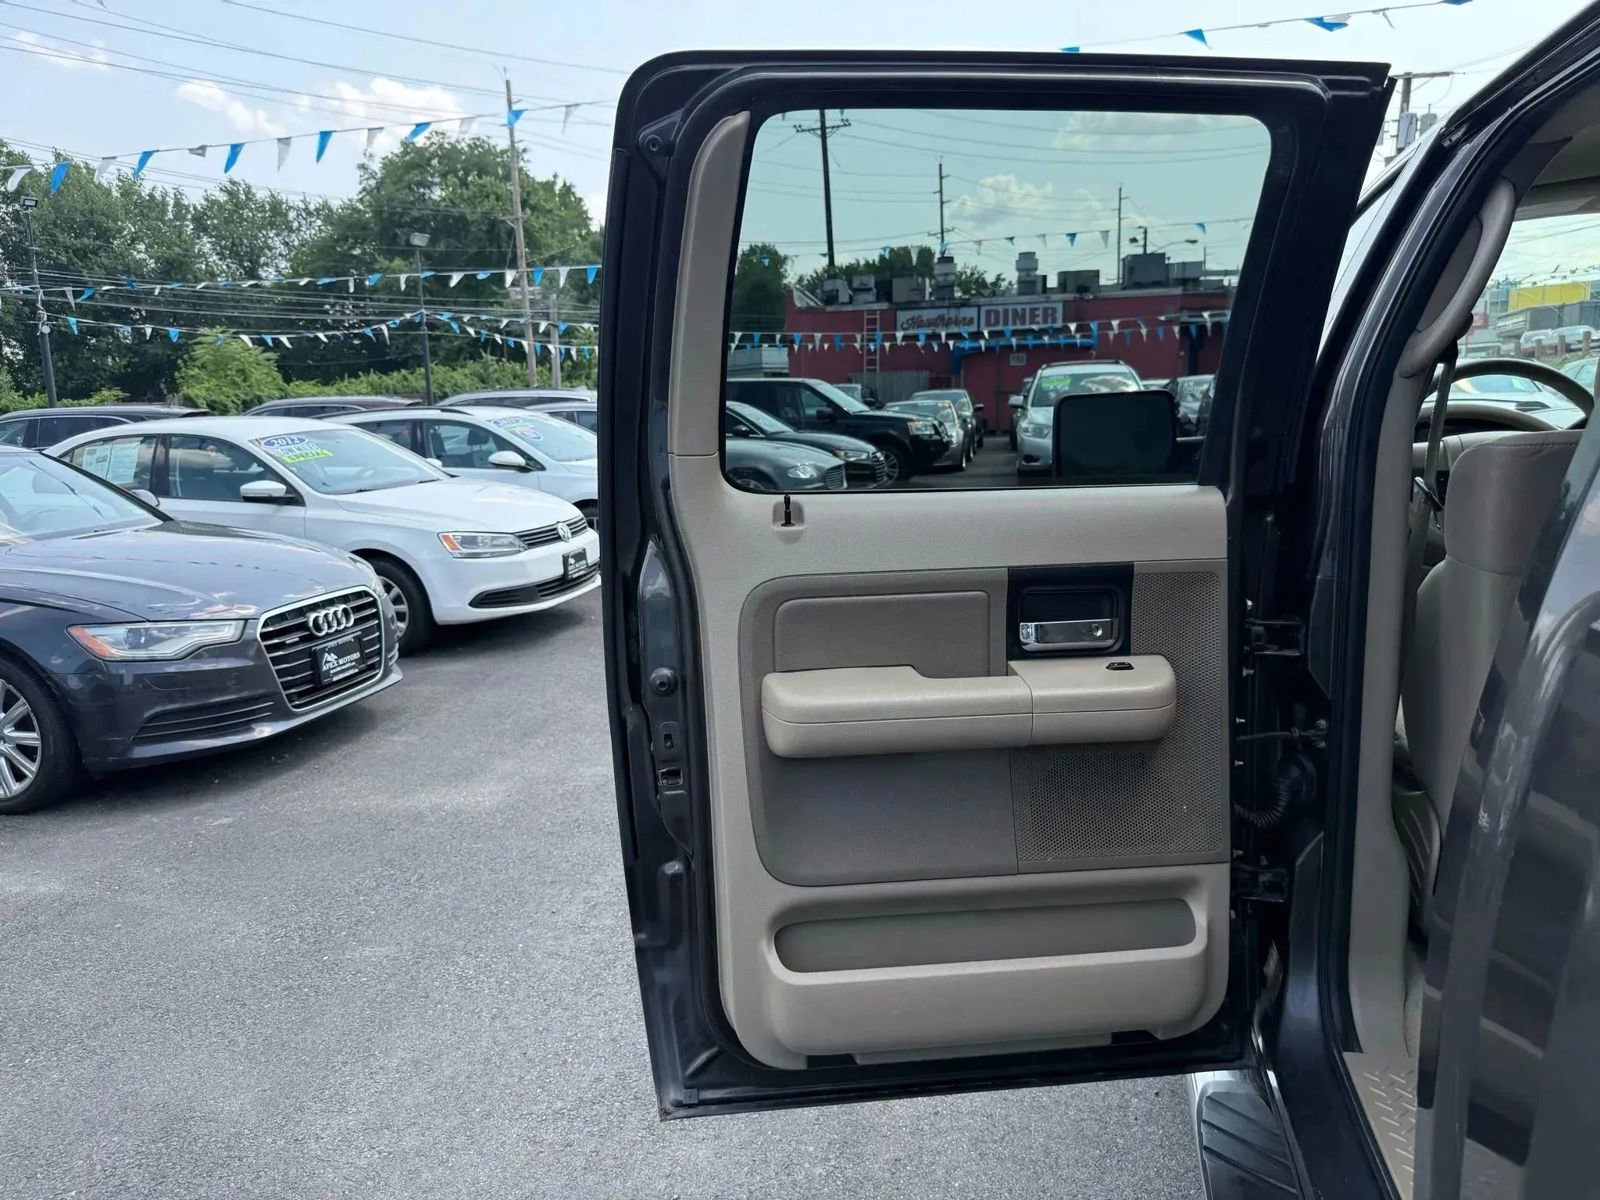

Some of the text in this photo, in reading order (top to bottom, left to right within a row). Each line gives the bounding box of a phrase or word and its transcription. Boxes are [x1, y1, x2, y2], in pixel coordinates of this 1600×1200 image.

[900, 306, 1058, 331] Hawthorne DINER
[270, 436, 301, 448] 2012
[322, 660, 338, 671] APEX
[338, 651, 360, 665] MOTORS
